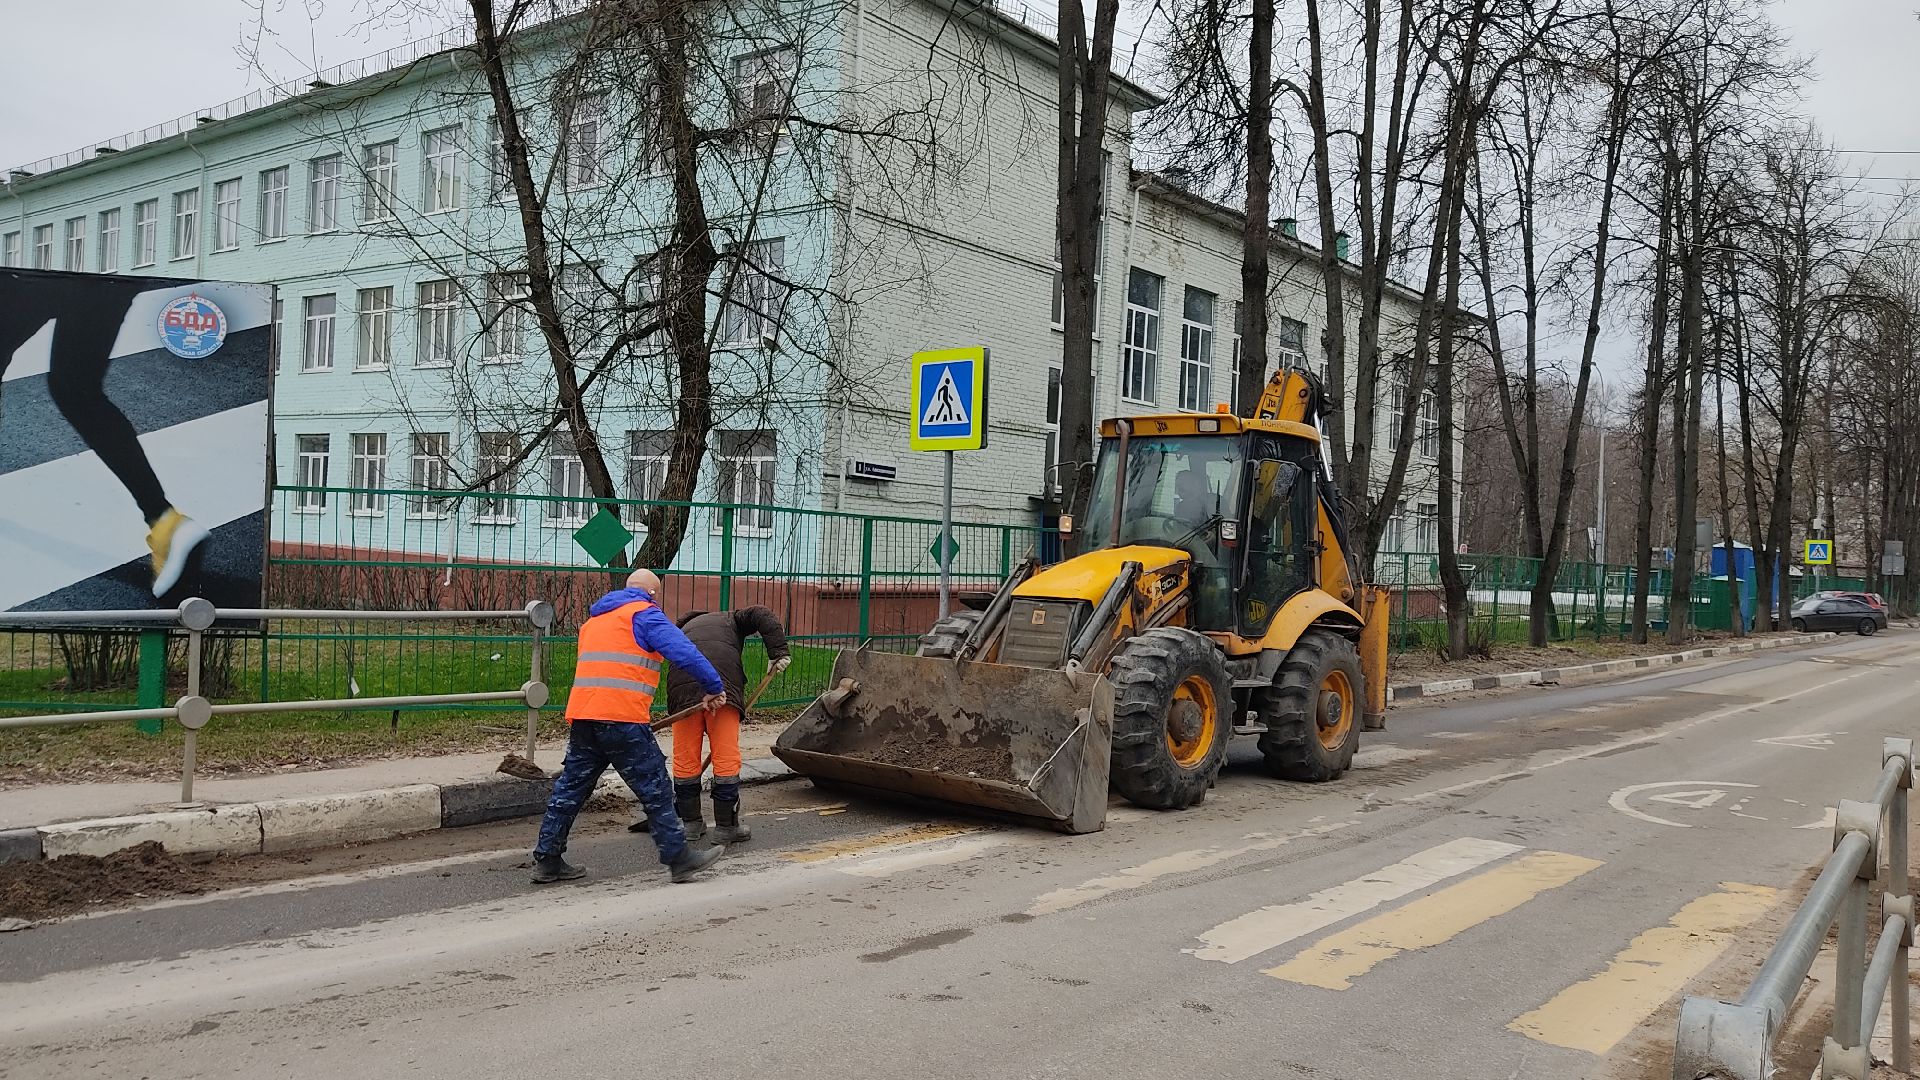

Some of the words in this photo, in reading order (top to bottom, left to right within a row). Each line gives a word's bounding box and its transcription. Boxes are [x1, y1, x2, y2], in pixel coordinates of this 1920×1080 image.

[165, 312, 217, 331] БДД
[1161, 575, 1178, 591] 3CX
[1249, 601, 1266, 622] JCB
